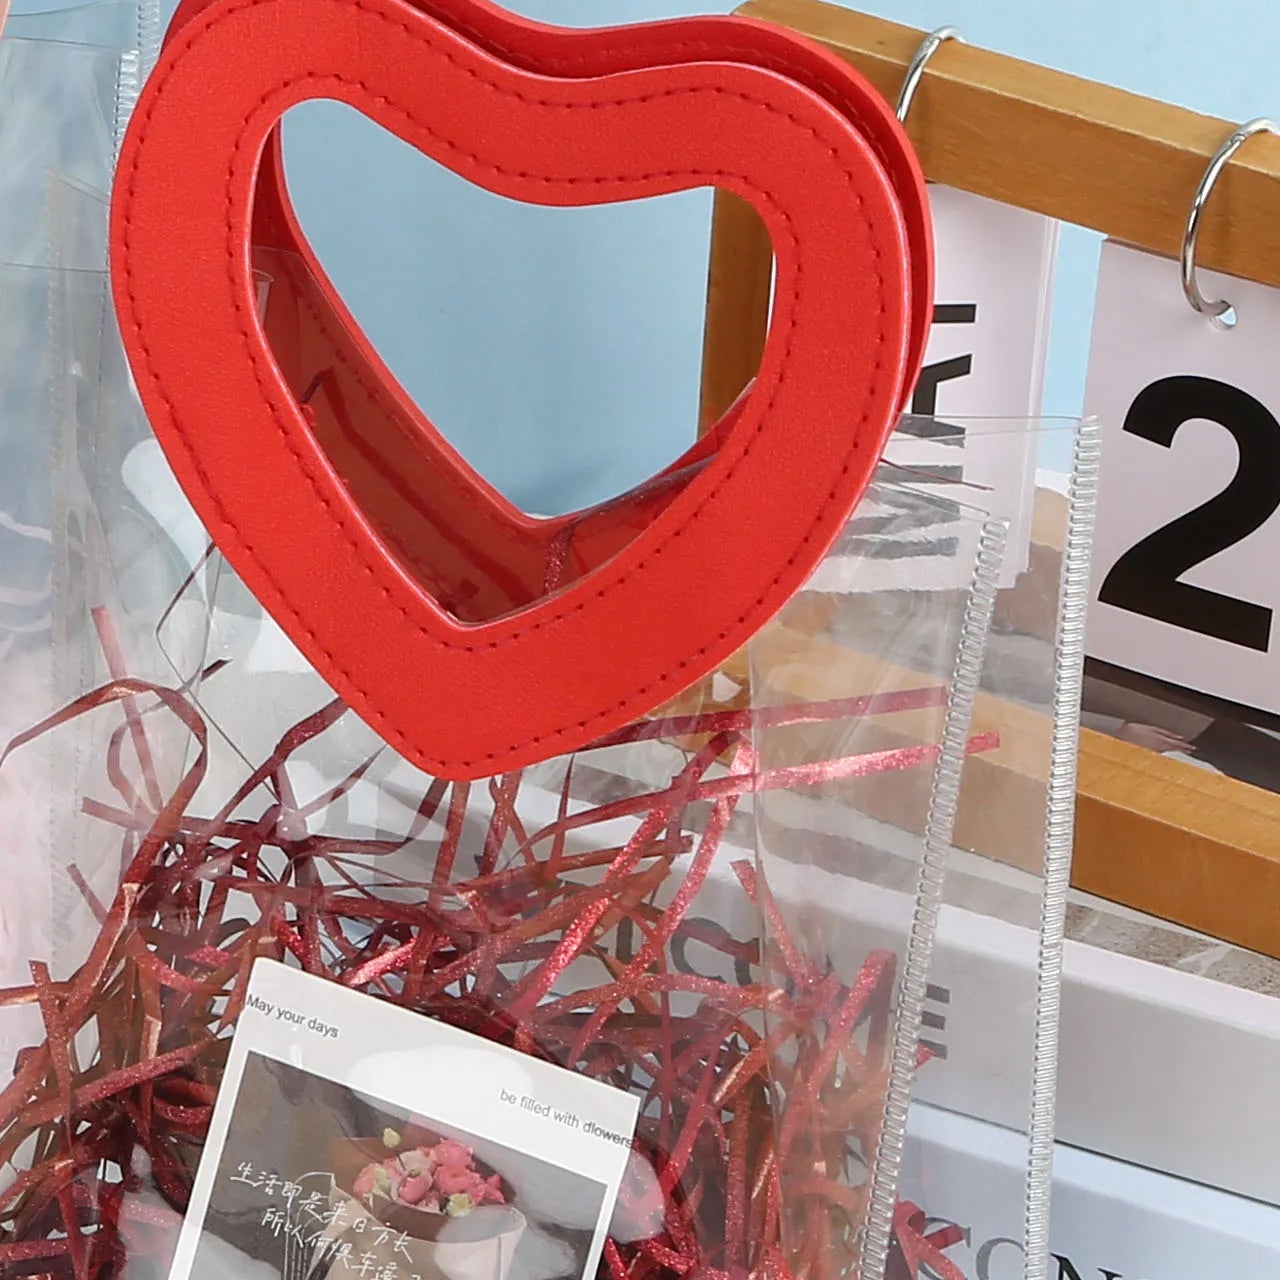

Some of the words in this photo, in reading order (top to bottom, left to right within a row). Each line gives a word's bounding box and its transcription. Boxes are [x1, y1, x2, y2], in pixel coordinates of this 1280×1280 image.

[247, 994, 275, 1016] May
[276, 1008, 306, 1025] your
[307, 1018, 339, 1038] days
[500, 1089, 517, 1105] be
[520, 1096, 551, 1118] filled
[553, 1110, 580, 1129] with
